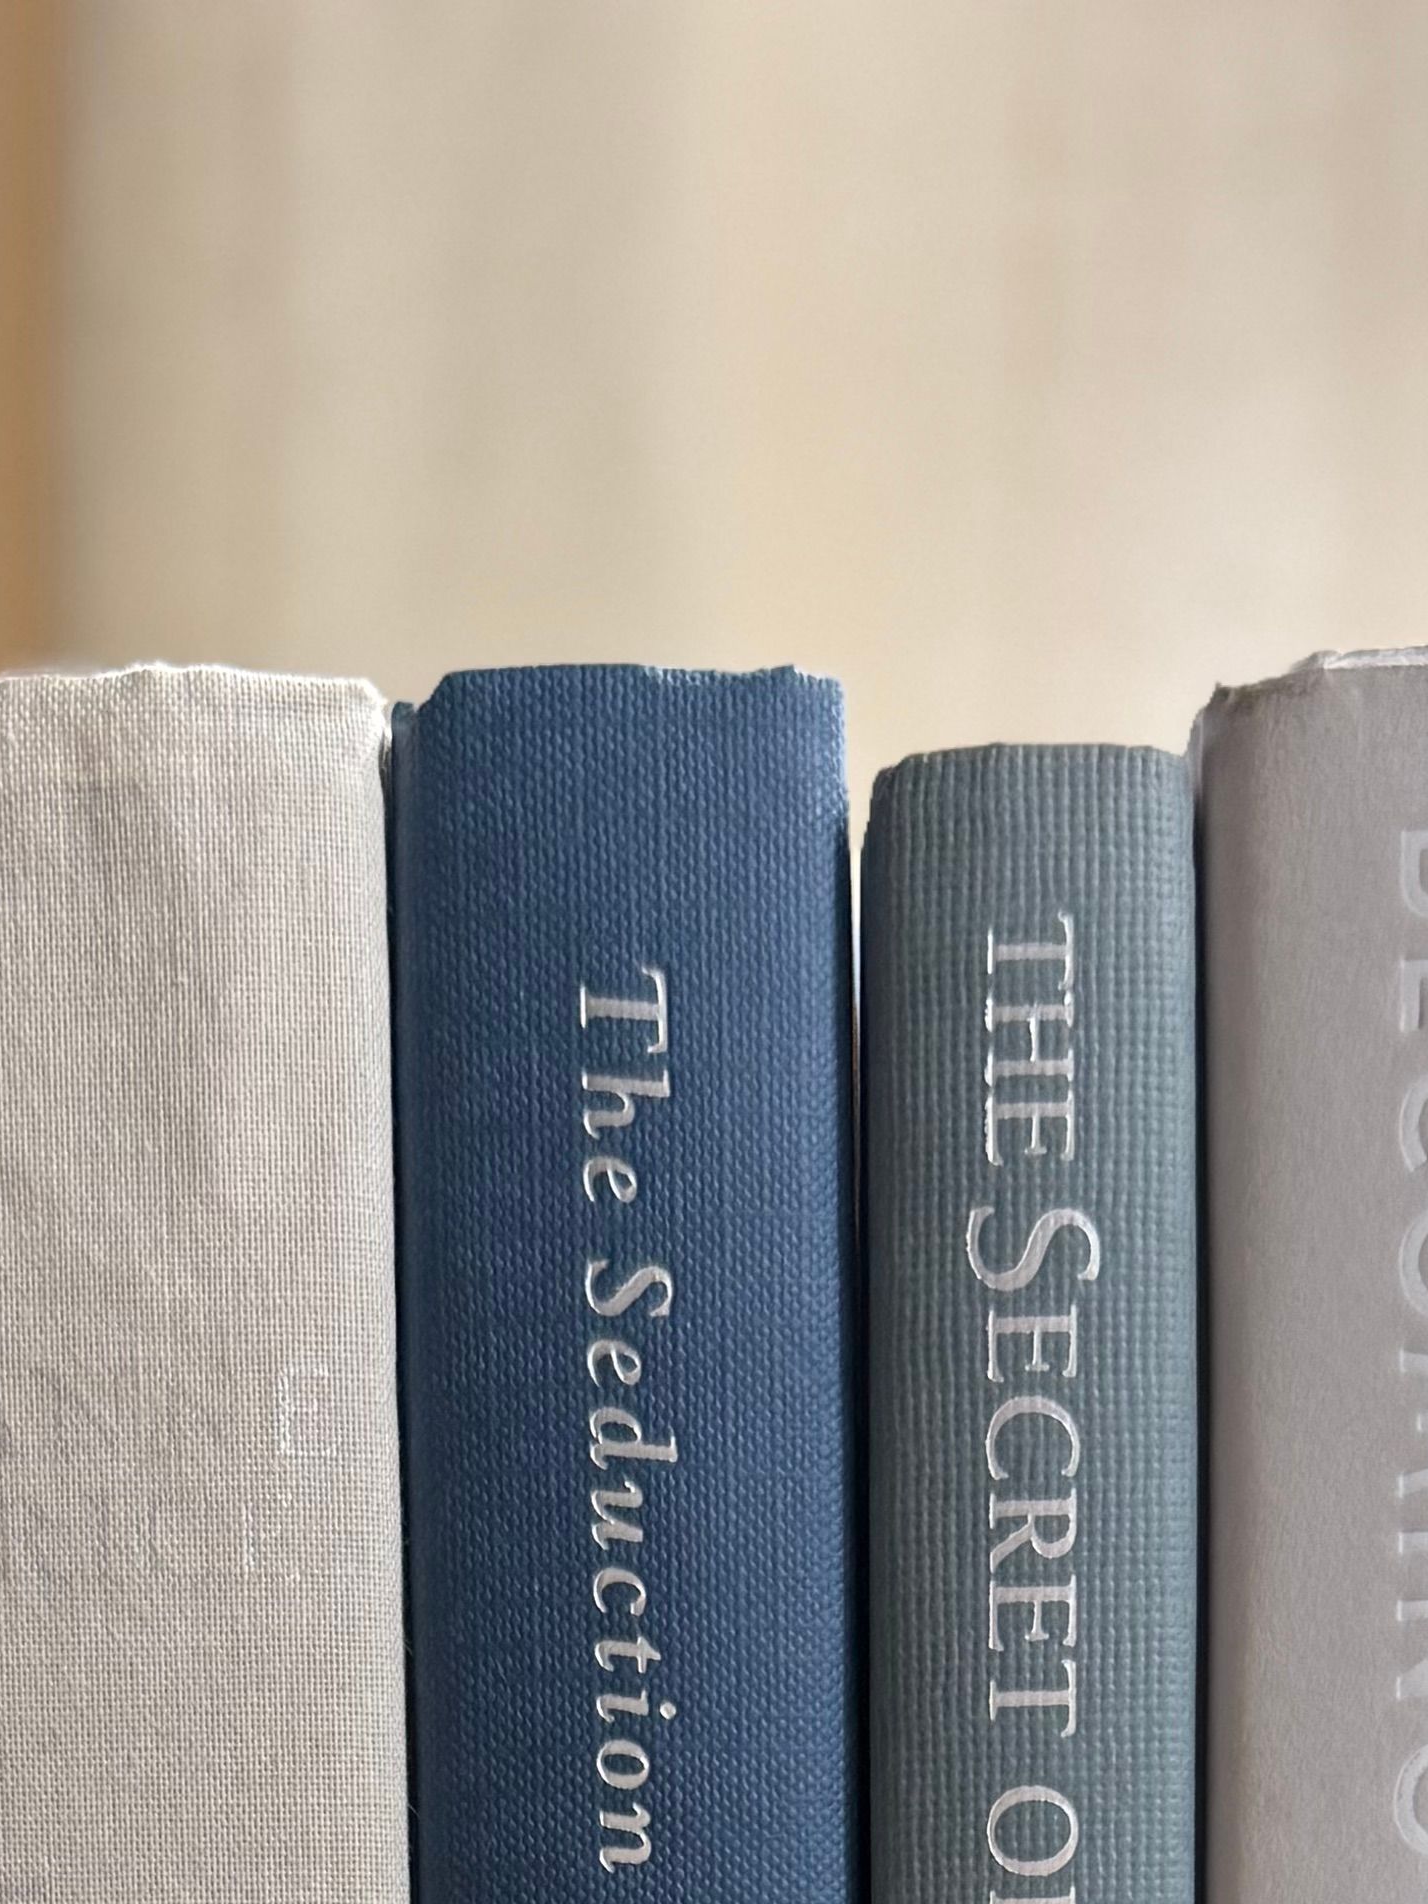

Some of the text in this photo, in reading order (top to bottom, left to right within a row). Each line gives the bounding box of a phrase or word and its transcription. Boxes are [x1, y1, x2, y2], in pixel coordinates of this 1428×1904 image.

[578, 965, 672, 1203] The
[983, 910, 1077, 1166] THE
[583, 1258, 680, 1874] Seduction
[966, 1205, 1101, 1738] SECRET
